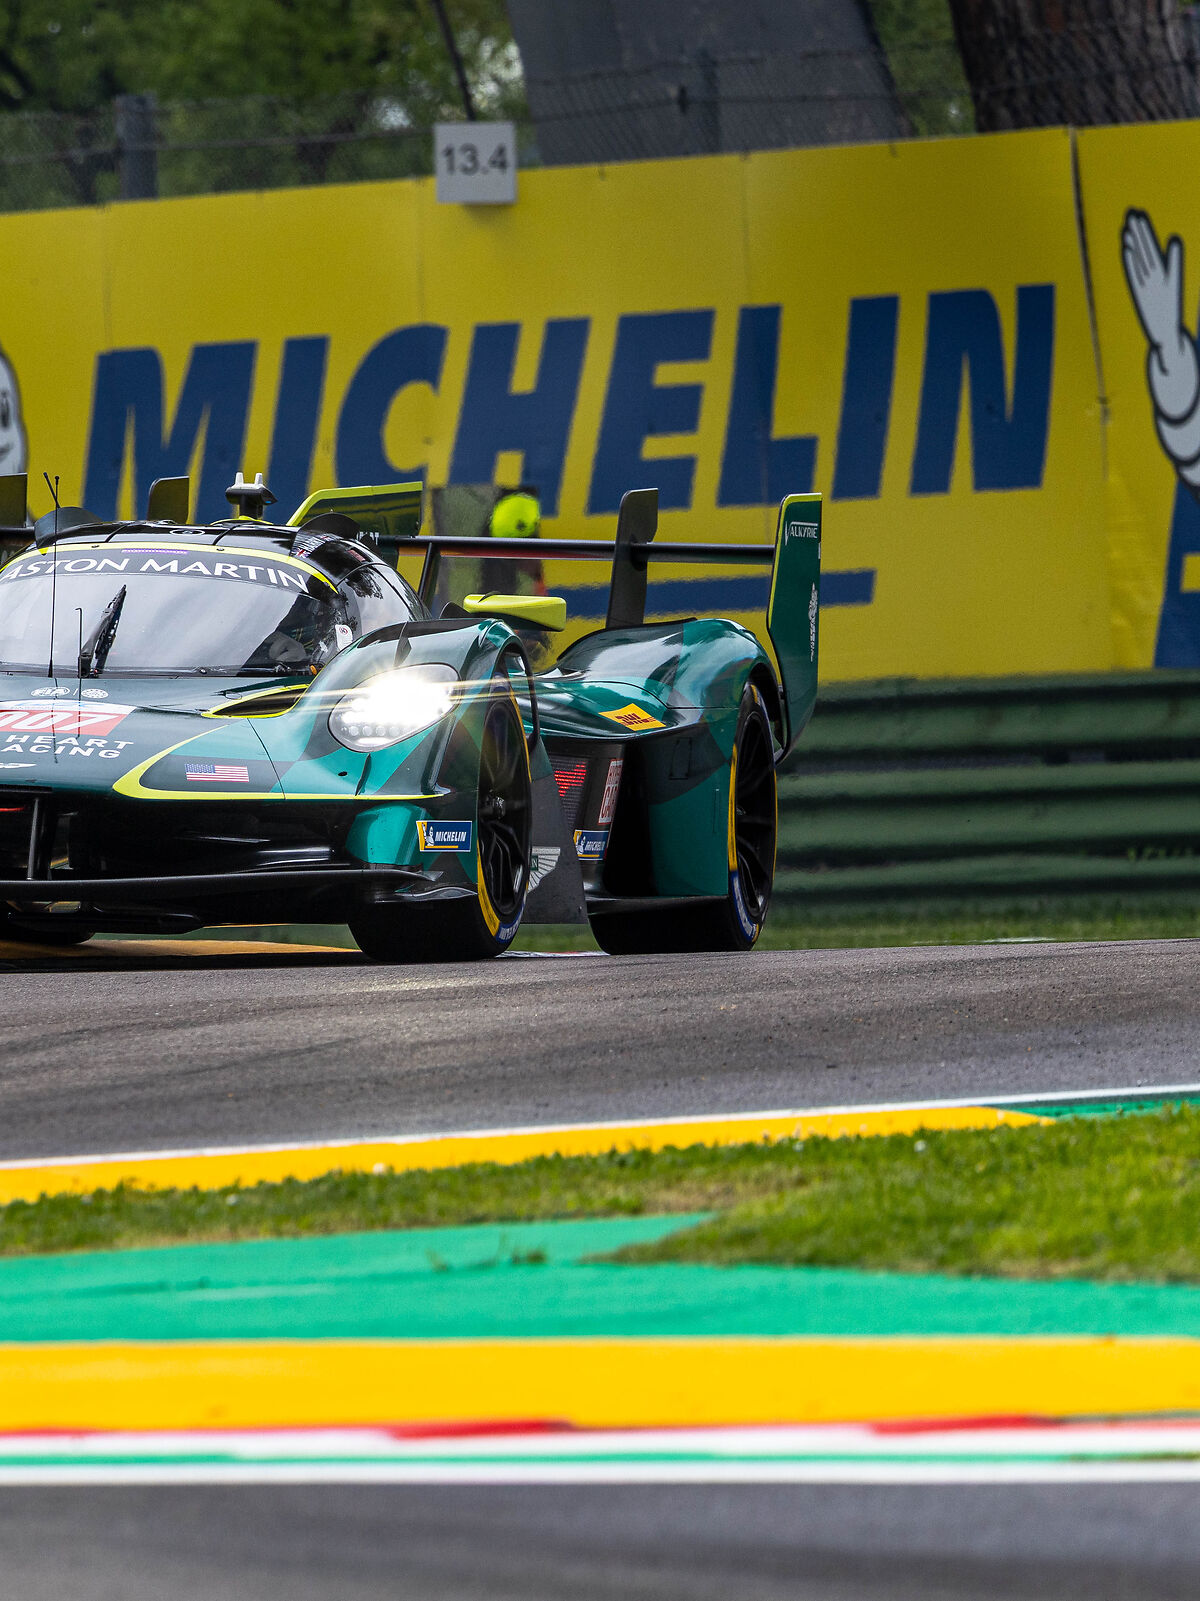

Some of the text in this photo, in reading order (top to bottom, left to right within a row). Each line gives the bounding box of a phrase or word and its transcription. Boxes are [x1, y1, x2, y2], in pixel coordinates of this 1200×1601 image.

[442, 143, 507, 175] 13.4
[83, 283, 1055, 521] MICHELIN
[784, 521, 818, 546] VALKYRIE
[140, 558, 308, 593] MARTIN
[6, 734, 135, 749] HEART
[435, 831, 467, 842] MICHELIN
